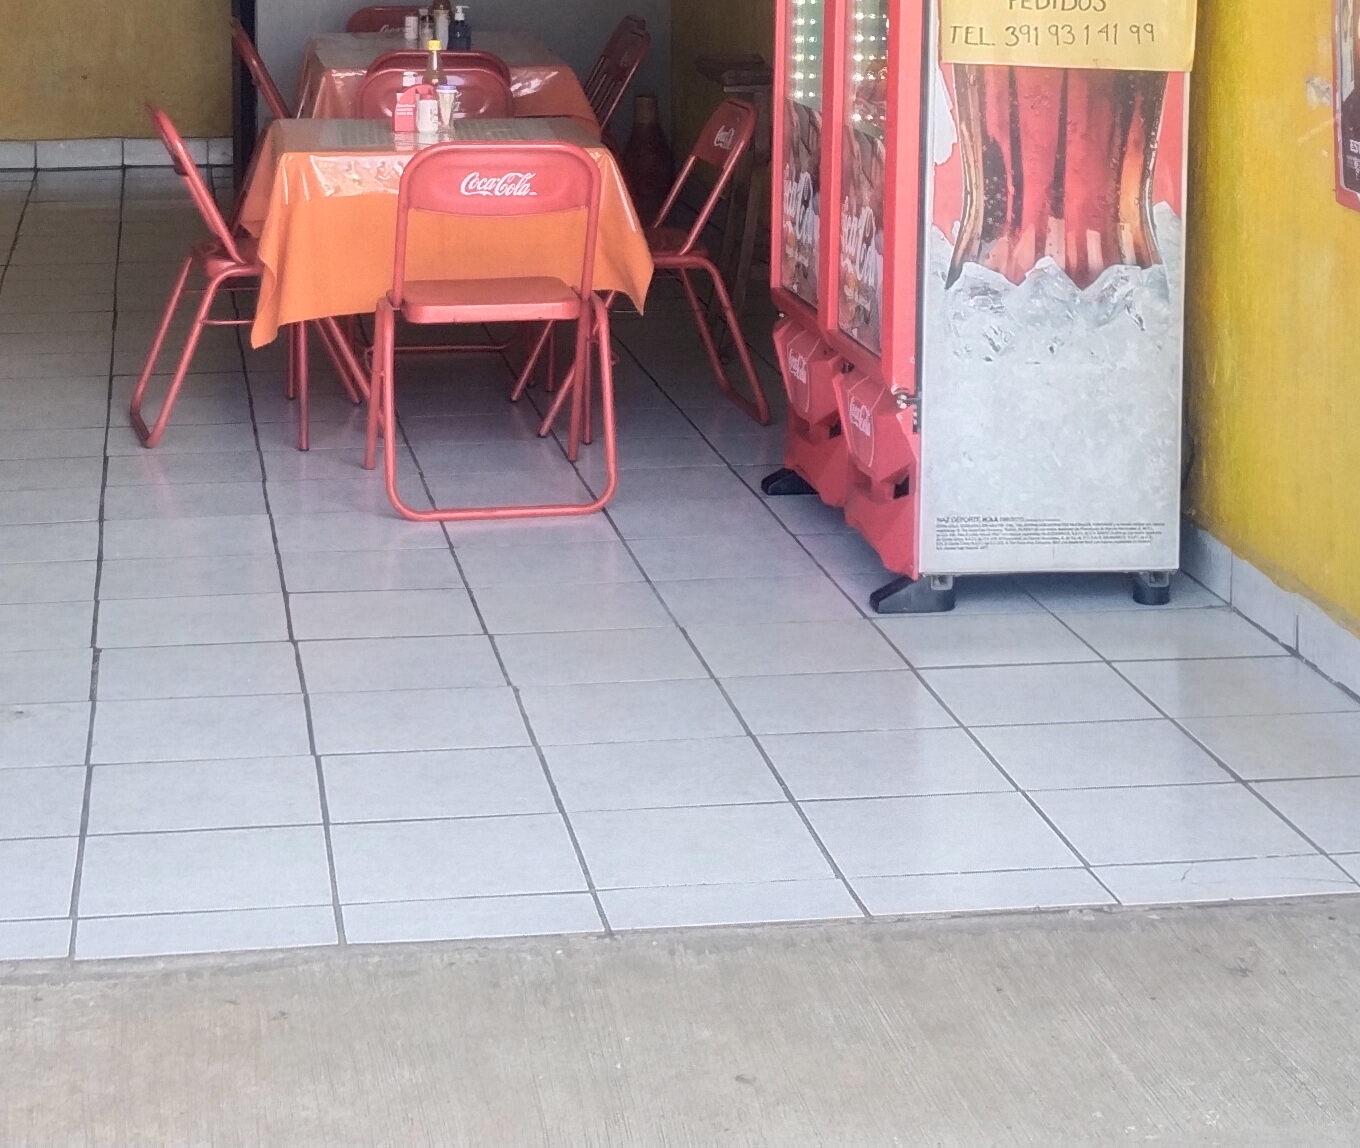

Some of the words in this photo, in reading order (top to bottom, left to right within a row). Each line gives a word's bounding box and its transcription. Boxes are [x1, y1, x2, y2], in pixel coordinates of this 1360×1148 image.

[1004, 24, 1039, 46] 391
[1048, 24, 1075, 46] 93
[1129, 23, 1155, 44] 99
[460, 172, 537, 196] Coca-Cola
